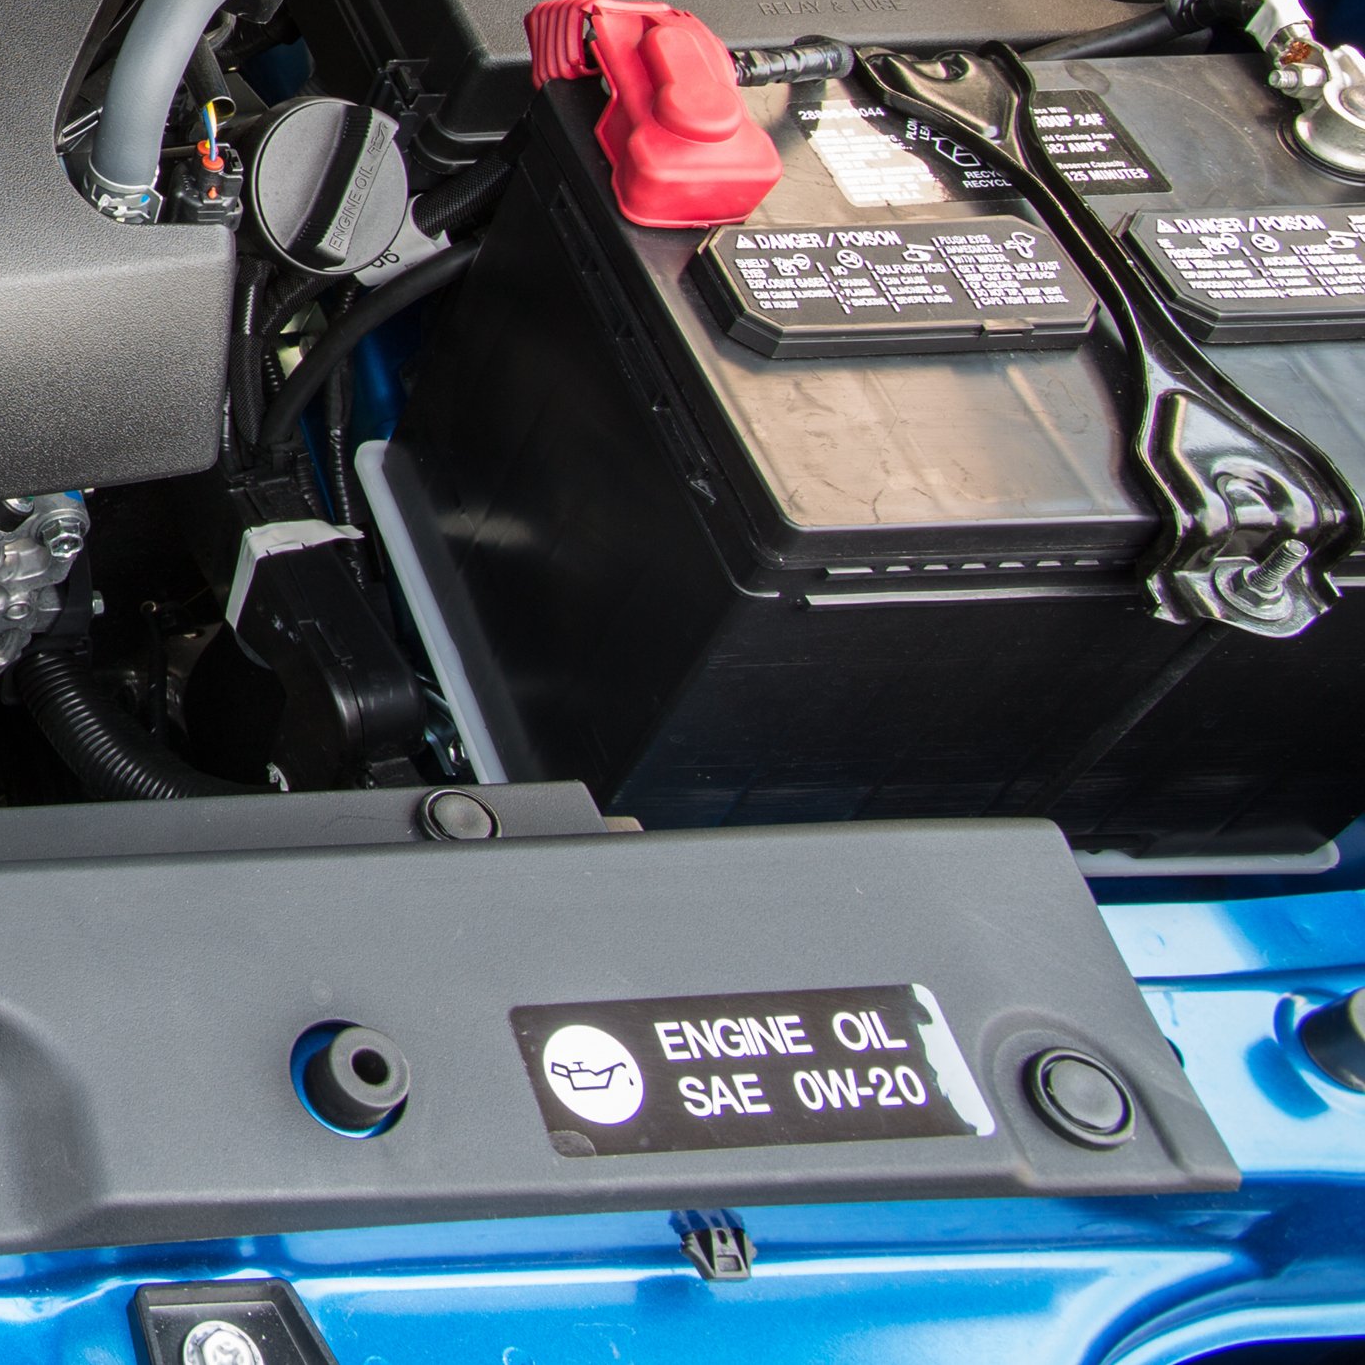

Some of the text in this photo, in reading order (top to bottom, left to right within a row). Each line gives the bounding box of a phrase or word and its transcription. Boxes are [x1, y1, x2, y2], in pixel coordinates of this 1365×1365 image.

[757, 0, 822, 17] RELAY
[831, 0, 849, 13] &
[1034, 113, 1105, 128] ROUP 24F
[1068, 141, 1107, 153] AMPS
[1056, 160, 1127, 170] Reserve Capacity
[1063, 168, 1150, 182] 125 MINUTES
[328, 165, 376, 252] ENGINE OIL
[1173, 217, 1247, 233] DANGER
[1256, 215, 1326, 232] POISON
[754, 233, 825, 249] DANGER
[836, 230, 902, 247] POISON
[653, 1011, 909, 1062] ENGINE OIL
[677, 1065, 928, 1118] SAE 0W-20
